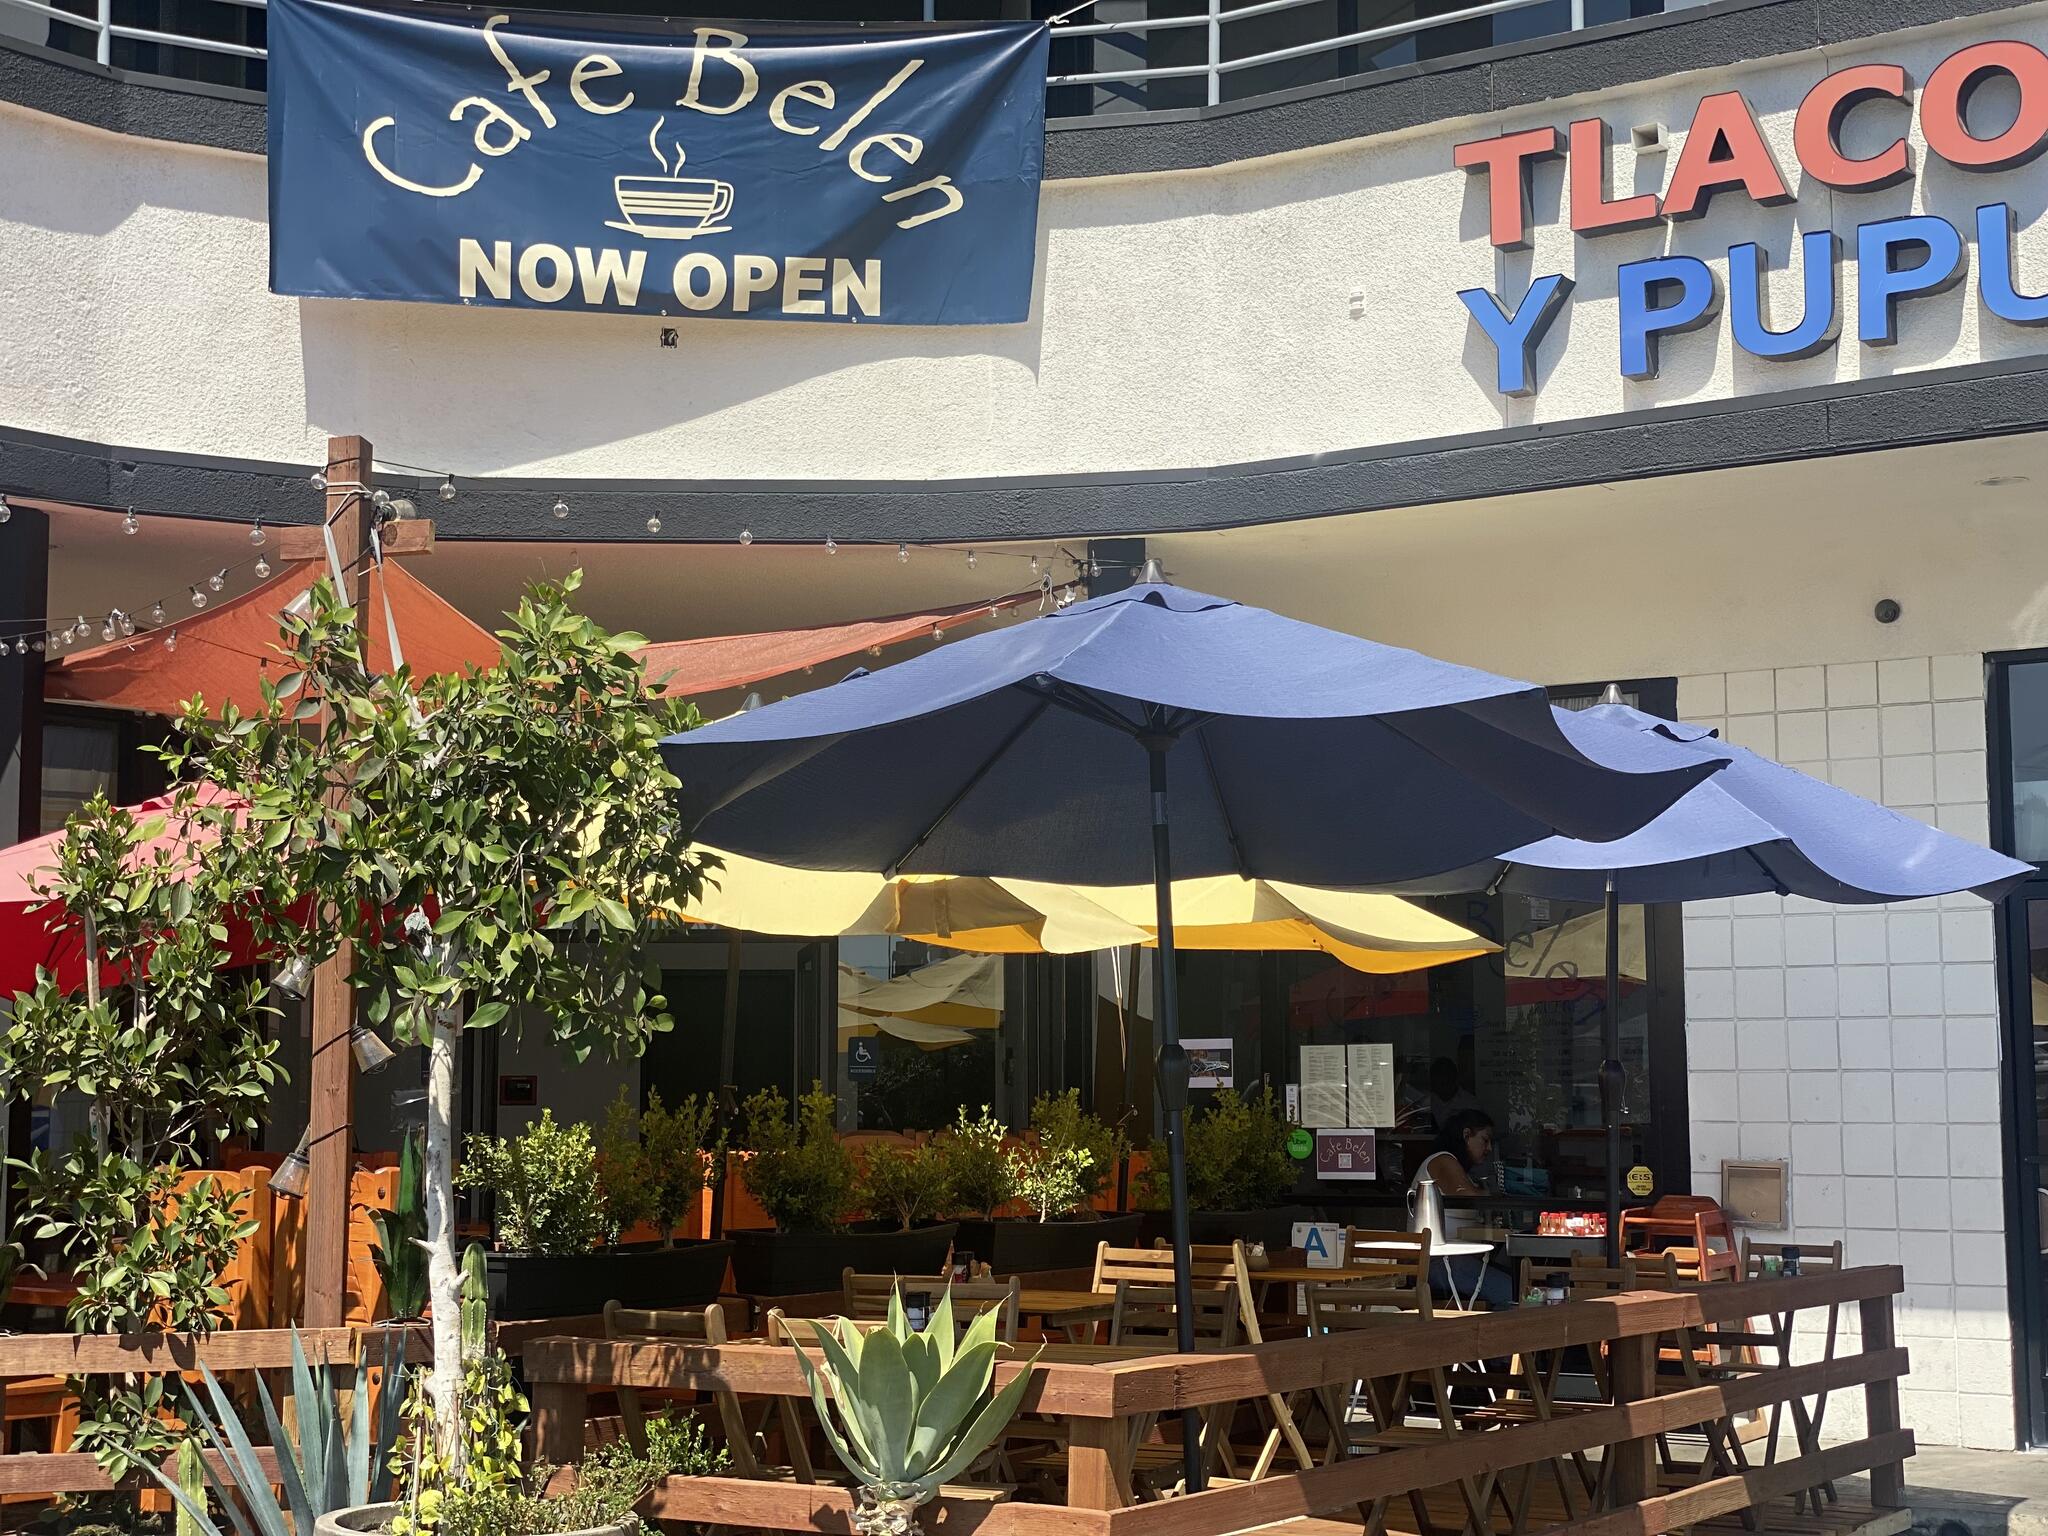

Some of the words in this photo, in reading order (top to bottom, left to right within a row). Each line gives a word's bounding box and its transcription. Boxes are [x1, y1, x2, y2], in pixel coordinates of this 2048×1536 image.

[362, 14, 635, 197] Cafe
[676, 27, 964, 229] Belen
[1453, 39, 2048, 250] TLACO
[459, 238, 647, 306] NOW
[673, 252, 882, 317] OPEN
[1455, 273, 1576, 397] Y
[1617, 202, 2048, 381] PUPU
[1319, 1137, 1342, 1163] Cafe
[1345, 1137, 1371, 1164] Belen
[1304, 1227, 1328, 1258] A
